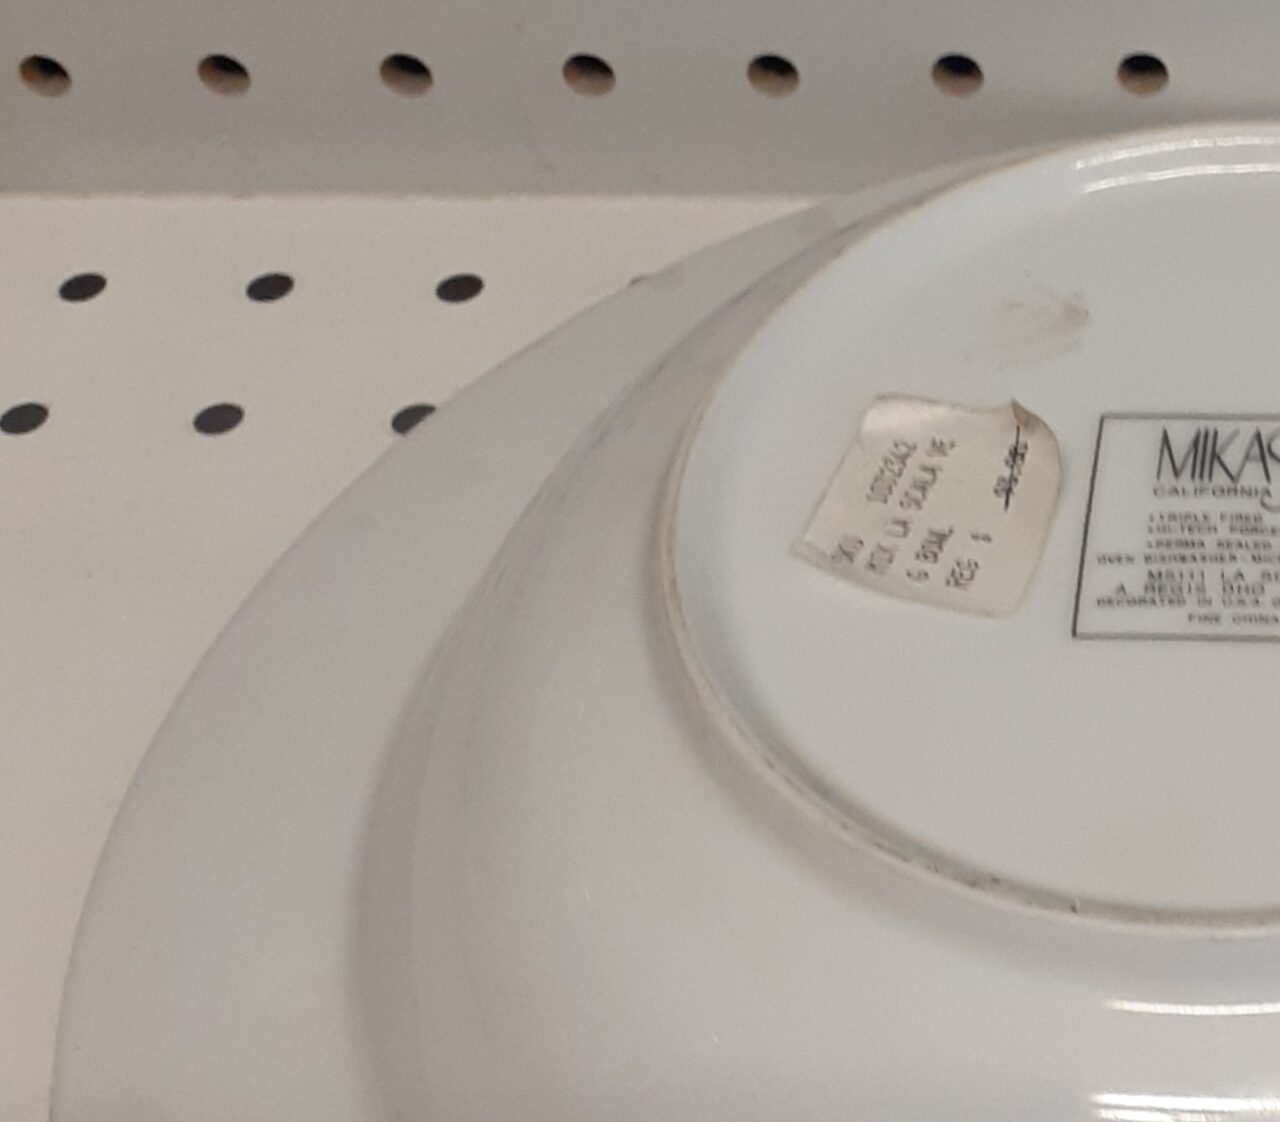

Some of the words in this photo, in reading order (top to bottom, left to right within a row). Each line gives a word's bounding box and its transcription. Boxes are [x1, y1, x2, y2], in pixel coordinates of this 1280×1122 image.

[1152, 485, 1272, 500] CALIFORNIA
[1220, 568, 1246, 582] LA
[1114, 582, 1128, 596] A
[1187, 612, 1222, 624] FINE
[1231, 612, 1280, 625] CHINA
